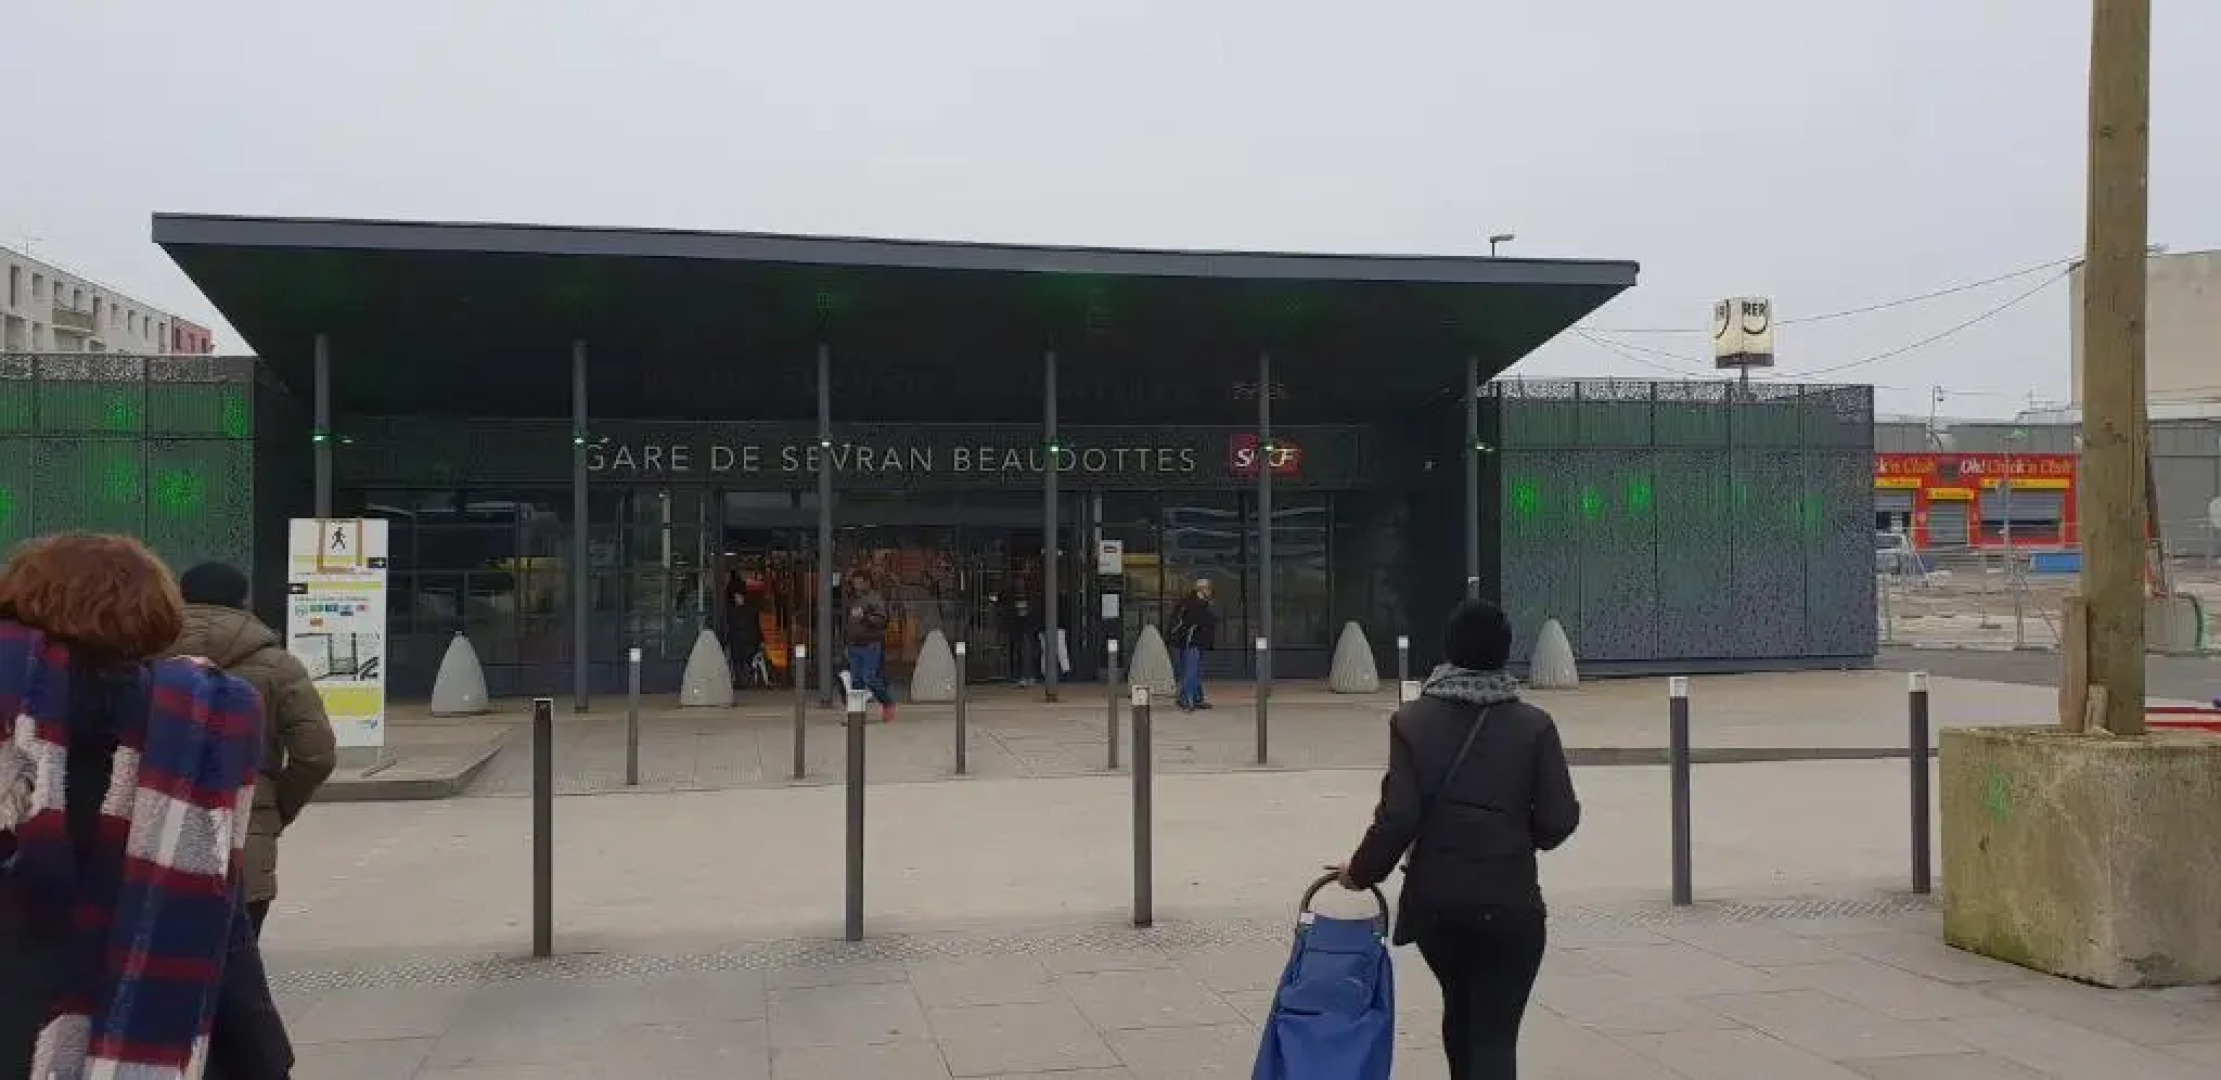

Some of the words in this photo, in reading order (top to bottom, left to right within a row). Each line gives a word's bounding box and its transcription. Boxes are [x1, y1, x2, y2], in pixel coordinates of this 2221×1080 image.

[1742, 303, 1767, 317] RER
[587, 446, 690, 471] GARE
[711, 446, 760, 471] DE
[782, 446, 933, 472] SEVRAN
[953, 448, 1196, 472] BEAUDOTTES
[1234, 448, 1301, 467] SCF
[1960, 458, 1985, 473] Oh!
